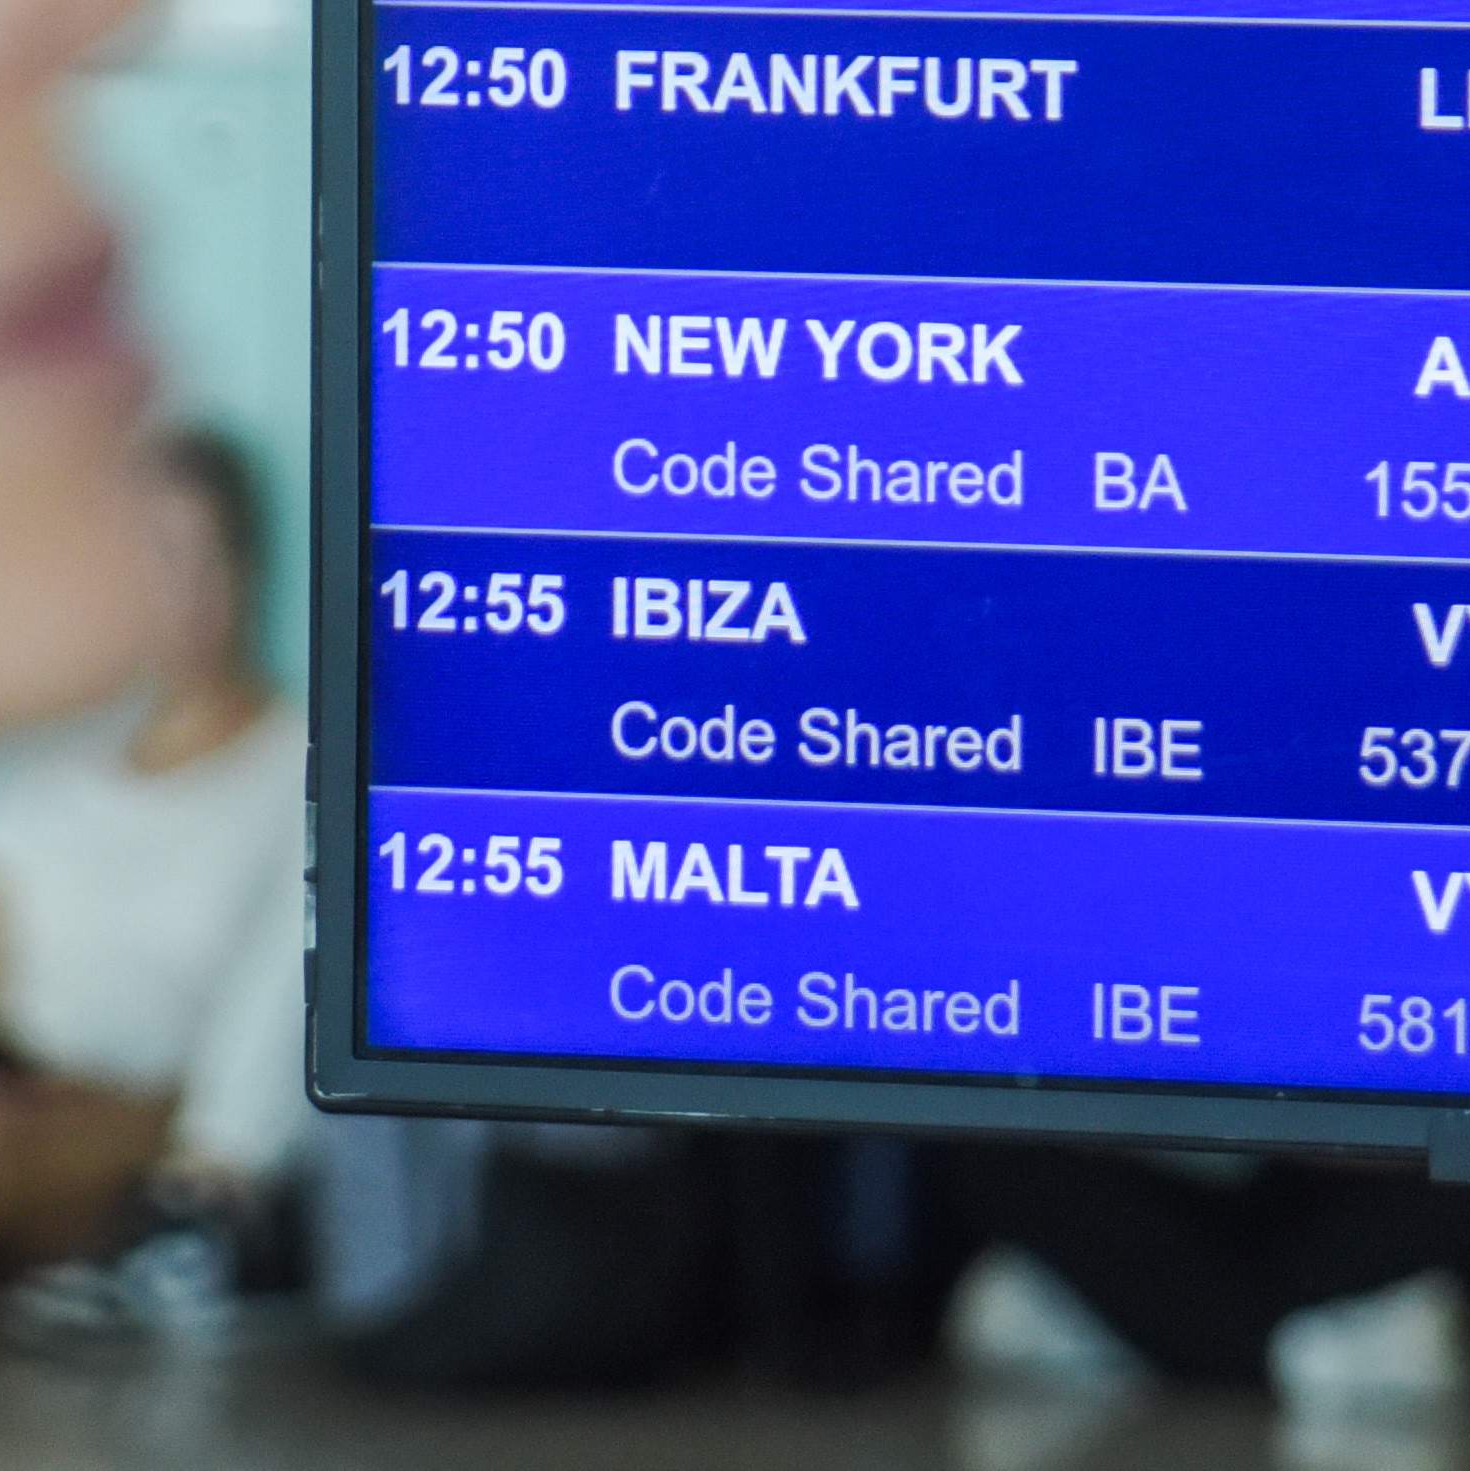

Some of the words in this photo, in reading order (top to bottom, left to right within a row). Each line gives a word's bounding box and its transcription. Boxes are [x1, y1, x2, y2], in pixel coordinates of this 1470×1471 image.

[382, 44, 568, 110] 12:50
[615, 49, 1078, 122] FRANKFURT
[381, 306, 567, 373] 12:50
[613, 312, 790, 380] NEW
[802, 317, 1027, 387] YORK
[612, 437, 778, 500] Code
[799, 442, 1024, 507] Shared
[1093, 451, 1189, 512] BA
[380, 569, 566, 636] 12:55
[612, 575, 807, 645] IBIZA
[611, 700, 776, 763] Code
[797, 706, 1022, 771] Shared
[1094, 716, 1203, 779] IBE
[378, 831, 564, 898] 12:55
[610, 839, 861, 910] MALTA
[609, 963, 773, 1025] Code
[796, 970, 1020, 1036] Shared
[1093, 982, 1201, 1044] IBE
